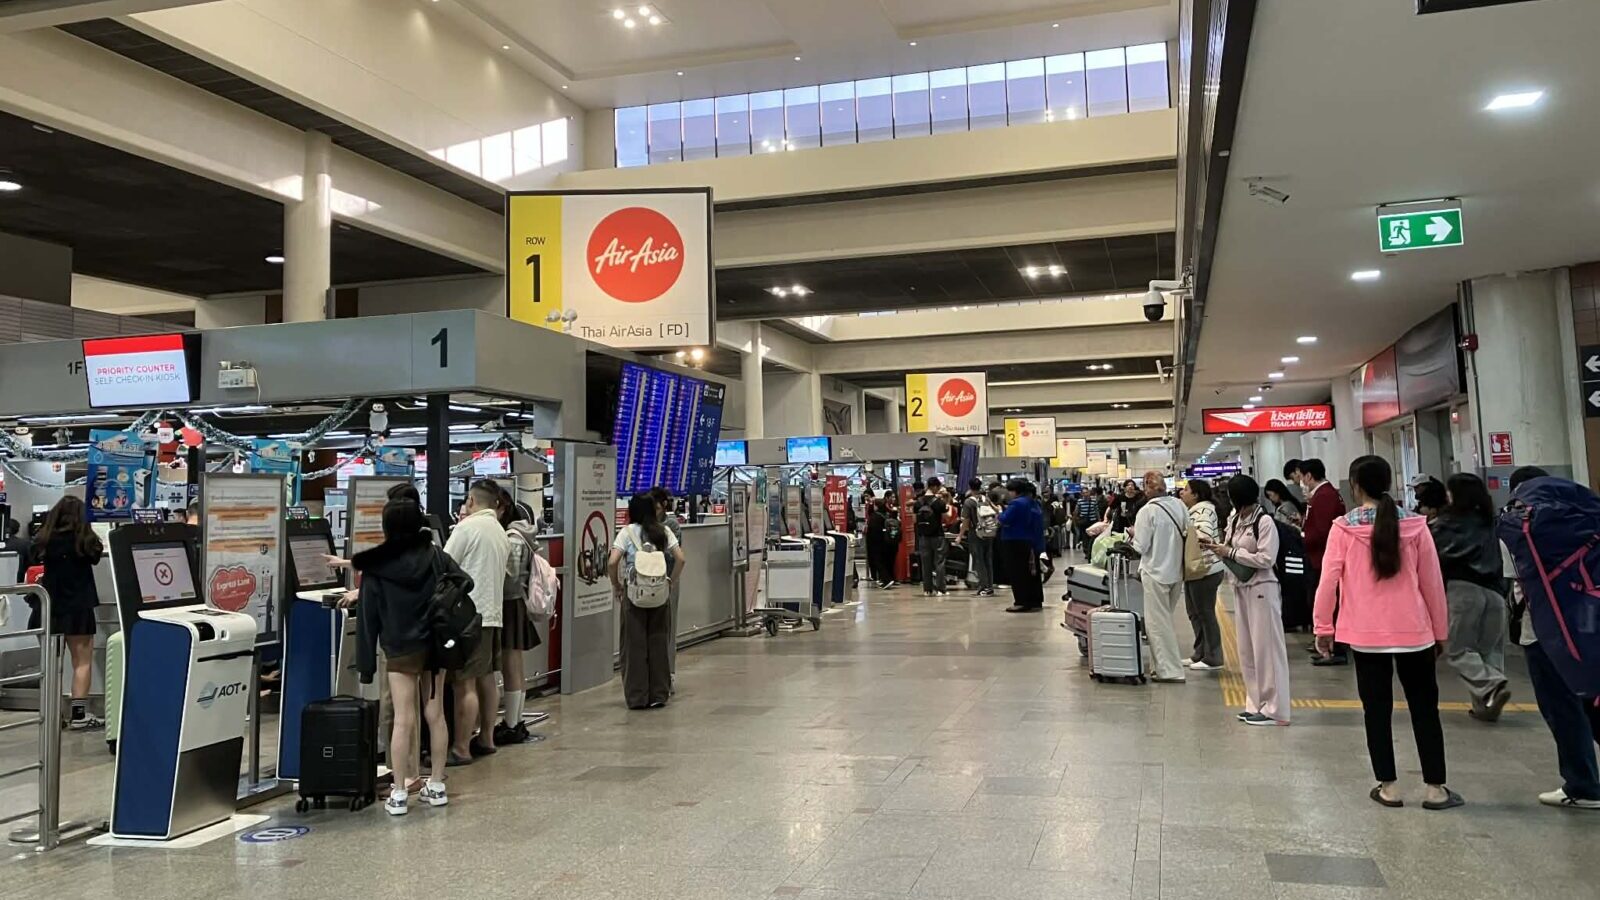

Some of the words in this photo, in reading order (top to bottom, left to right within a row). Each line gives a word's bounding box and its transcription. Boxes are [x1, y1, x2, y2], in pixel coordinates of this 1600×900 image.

[526, 236, 546, 246] ROW
[526, 254, 541, 302] 1
[580, 326, 606, 338] Thai
[609, 325, 653, 338] AirAsia
[431, 328, 448, 368] 1
[97, 366, 134, 376] PRIORITY
[136, 363, 175, 374] COUNTER
[94, 376, 113, 386] SELF
[156, 372, 180, 382] KIOSK
[911, 397, 923, 417] 2
[1270, 420, 1306, 428] THAILAND
[918, 438, 928, 451] 2
[1008, 433, 1016, 446] 3
[1020, 460, 1027, 469] 3
[829, 492, 844, 503] XTRA
[218, 682, 242, 698] AOT
